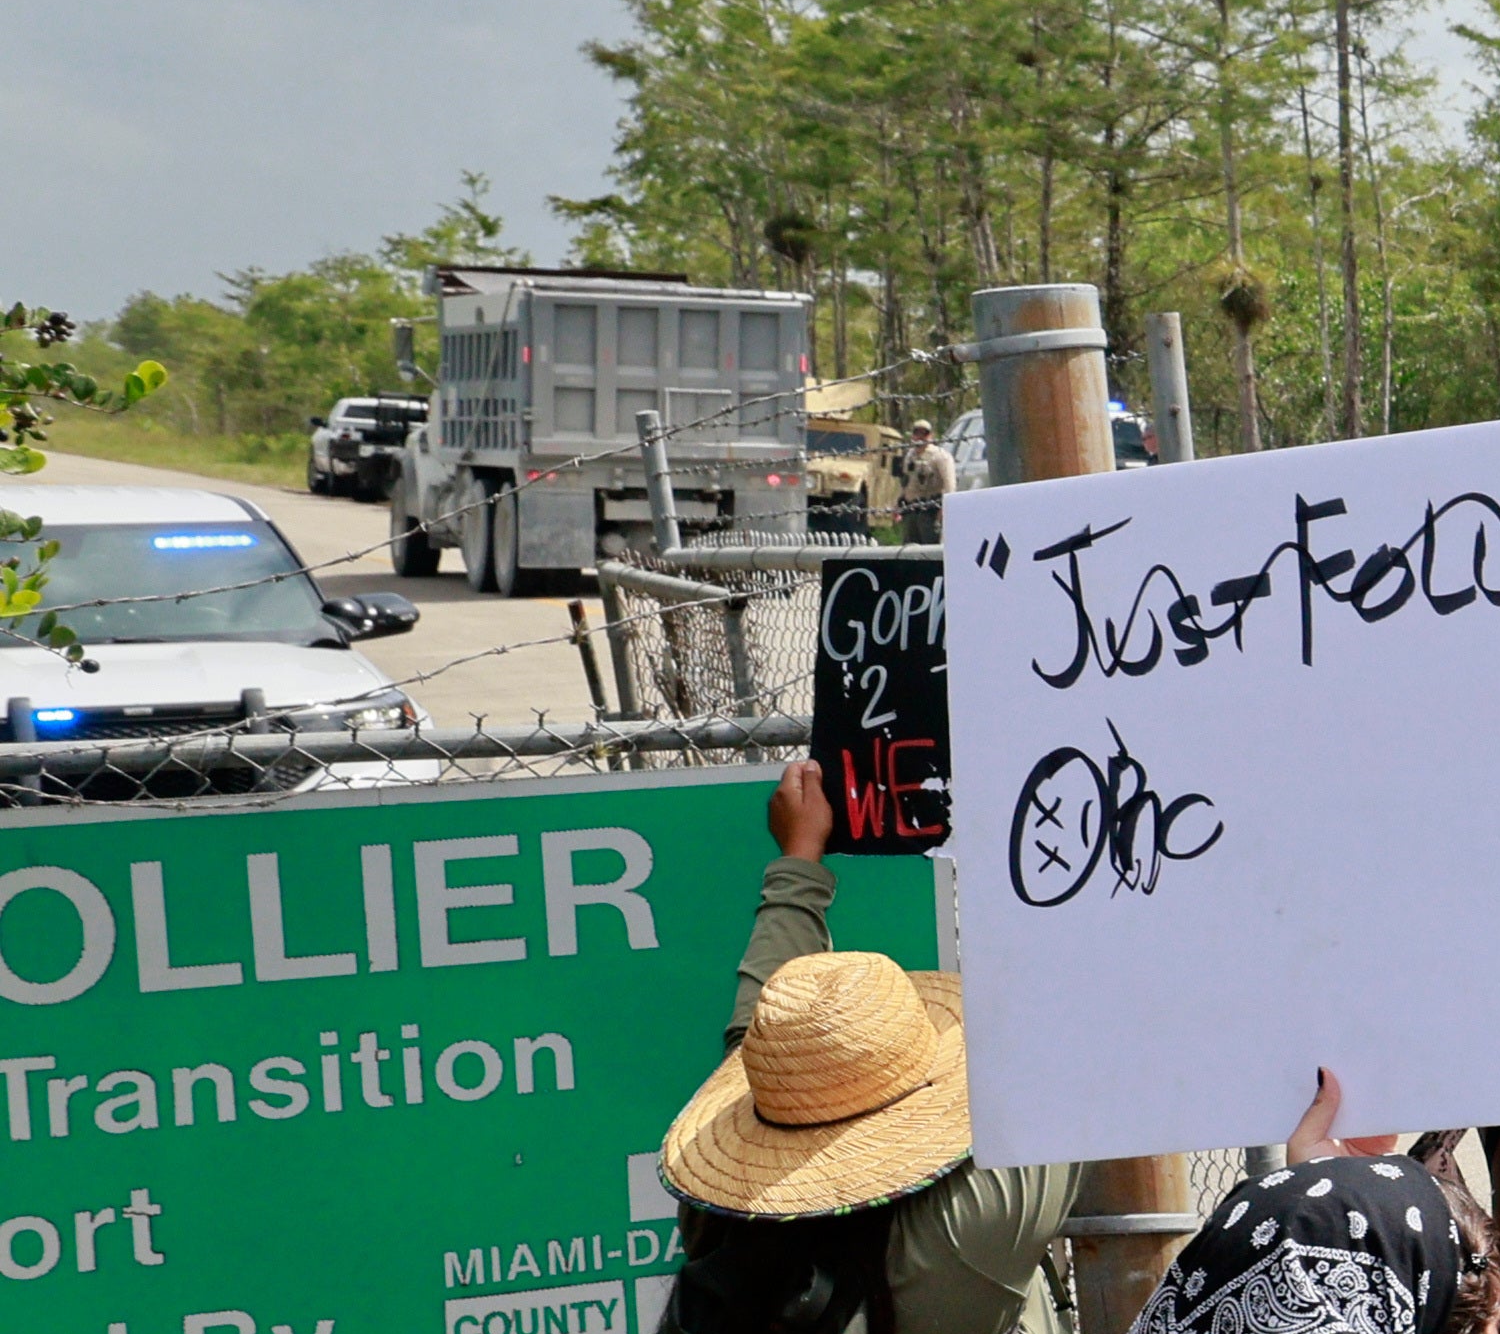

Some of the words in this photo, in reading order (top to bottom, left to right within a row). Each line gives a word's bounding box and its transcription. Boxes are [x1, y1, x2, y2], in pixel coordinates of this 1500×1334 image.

[860, 665, 897, 729] 2
[0, 825, 661, 1006] OLLIER
[0, 1023, 576, 1142] Transition
[0, 1188, 165, 1280] ort
